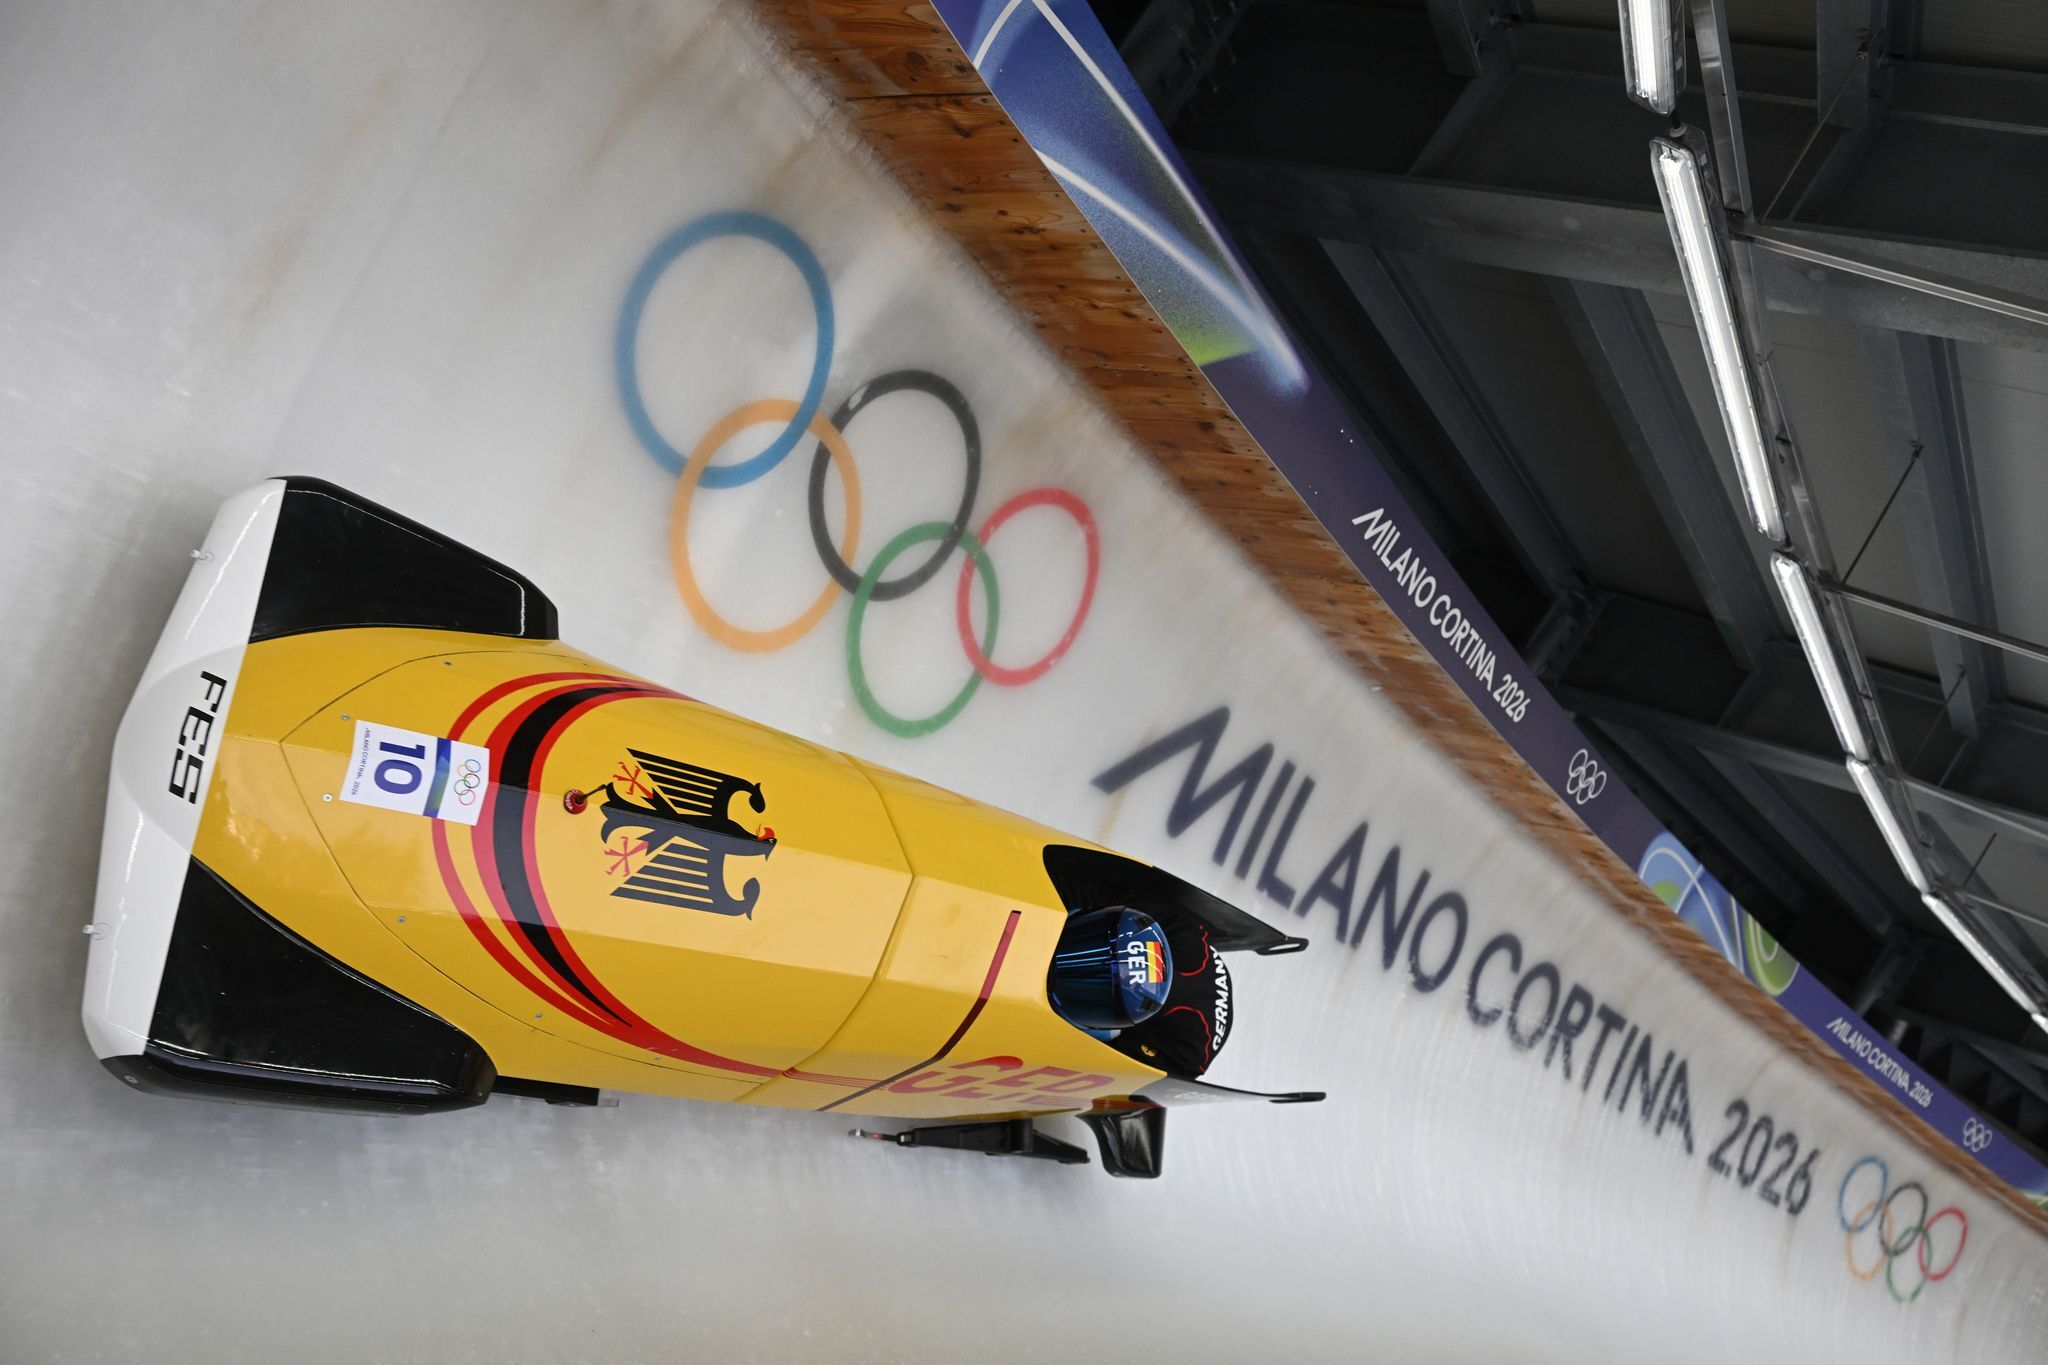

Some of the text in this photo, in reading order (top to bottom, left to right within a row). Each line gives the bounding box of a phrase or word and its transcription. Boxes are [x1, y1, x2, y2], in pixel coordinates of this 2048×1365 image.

[1351, 507, 1532, 723] MILANO CORTINA 2026
[168, 670, 228, 805] FES
[374, 741, 426, 795] 10
[1090, 705, 1822, 1217] MILANO CORTINA 2026
[1126, 940, 1147, 985] GER
[1209, 945, 1229, 1051] GERMANY
[1826, 1016, 1934, 1108] MILANO CORTINA 2026
